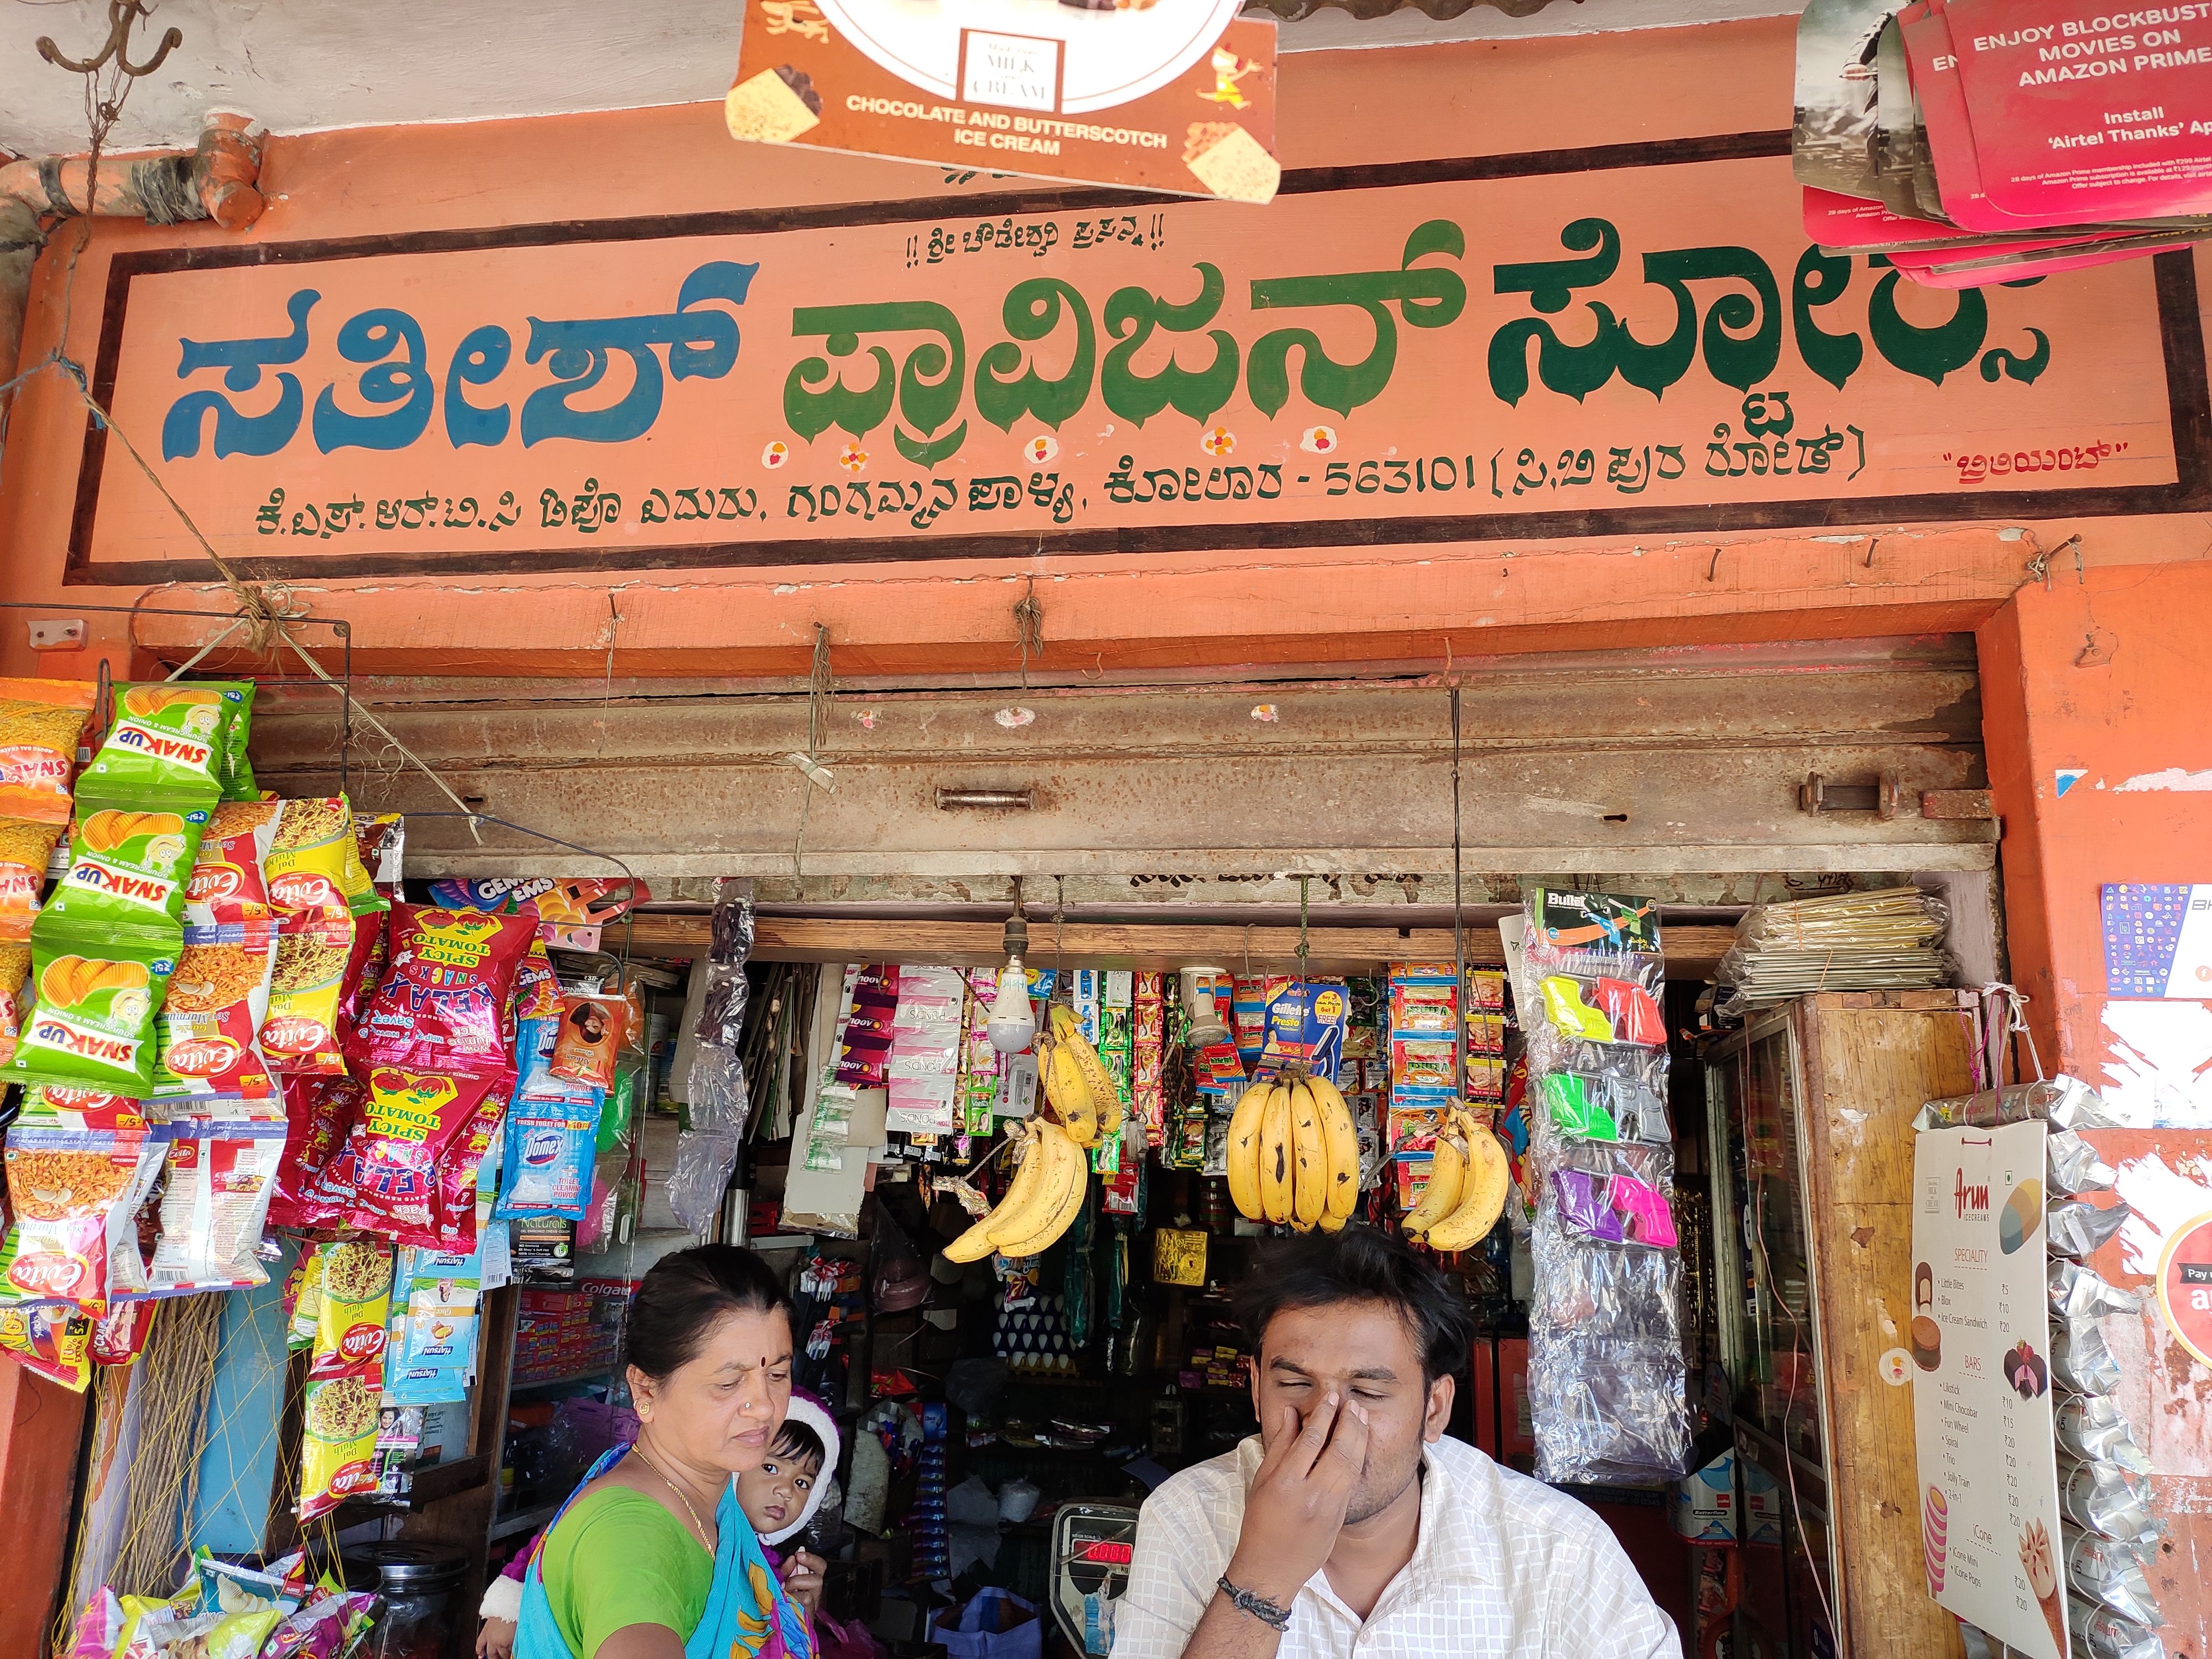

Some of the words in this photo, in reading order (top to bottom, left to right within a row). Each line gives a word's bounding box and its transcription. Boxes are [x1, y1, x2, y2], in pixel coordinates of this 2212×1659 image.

[1973, 24, 2055, 52] ENJOY
[2038, 32, 2136, 62] MOVIES
[2143, 28, 2181, 48] ON
[2019, 55, 2129, 87] AMAZON
[2134, 46, 2212, 71] PRIME
[846, 95, 966, 124] CHOCOLATE
[969, 112, 1011, 129] AND
[1014, 117, 1167, 148] BUTTERSCOTCH
[2104, 107, 2164, 126] Install
[954, 128, 987, 147] ICE
[989, 133, 1061, 155] CREAM
[2042, 176, 2069, 185] Amazon
[2069, 175, 2089, 183] Prime
[2089, 170, 2129, 181] subscription
[2136, 167, 2165, 176] available
[2045, 170, 2072, 179] Amazon
[2092, 164, 2132, 175] membership
[2132, 160, 2161, 170] included
[2089, 180, 2113, 189] subject
[2148, 174, 2158, 182] For
[163, 261, 760, 463] ಸತೀಶ್
[783, 218, 1467, 472] ಪ್ರಾವಿಜನ್
[1325, 455, 1476, 495] 563101
[128, 716, 153, 727] ONION
[160, 723, 186, 736] CREAM
[118, 731, 144, 747] UP
[187, 732, 207, 744] SOUR
[145, 738, 207, 763] SNAK
[85, 851, 112, 863] ONION
[118, 859, 146, 872] CREAM
[278, 859, 296, 870] Dal
[76, 867, 102, 885] UP
[149, 868, 169, 879] SOUR
[101, 875, 167, 901] SNAK
[269, 878, 331, 906] Evita
[1547, 893, 1587, 907] Bullet
[413, 935, 489, 954] TOMATO
[419, 948, 477, 967] SPICY
[409, 964, 478, 987] SNACKS
[382, 971, 496, 1014] RELAX
[47, 1007, 75, 1020] ONION
[273, 1001, 291, 1012] Dal
[84, 1018, 111, 1031] CREAM
[1271, 1015, 1300, 1026] Presto
[38, 1026, 66, 1045] UP
[115, 1027, 136, 1039] SOUR
[262, 1025, 325, 1051] Evita
[451, 1024, 487, 1038] Pack
[65, 1034, 133, 1062] SNAK
[447, 1035, 494, 1047] Jumbo
[169, 1045, 234, 1073] Evita
[904, 1061, 941, 1072] POND'S
[364, 1103, 439, 1129] TOMATO
[900, 1113, 936, 1124] POND'S
[368, 1120, 425, 1142] SPICY
[168, 1146, 191, 1159] Evita
[526, 1138, 564, 1159] Domex
[1954, 1166, 1989, 1219] Arun
[393, 1204, 429, 1217] Pack
[1963, 1214, 1990, 1222] ICECREAMS
[1954, 1248, 1988, 1264] SPECIALITY
[13, 1263, 82, 1291] Evita
[2188, 1269, 2207, 1281] Pay
[1941, 1278, 1952, 1289] Little
[1953, 1280, 1964, 1290] Bites
[2001, 1284, 2009, 1296] ₹5
[344, 1303, 364, 1316] Muth
[1941, 1295, 1951, 1306] Blox
[1999, 1302, 2010, 1314] ₹10
[351, 1310, 363, 1322] Dal
[1949, 1313, 1964, 1326] Cream
[1964, 1316, 1988, 1330] Sandwich
[1999, 1321, 2010, 1333] ₹20
[343, 1329, 384, 1354] Evita
[423, 1347, 452, 1355] HATSUN
[1964, 1355, 1981, 1371] BARS
[409, 1370, 437, 1379] HATSUN
[1943, 1381, 1960, 1396] Likstick
[2002, 1396, 2013, 1410] ₹10
[1944, 1401, 1954, 1414] Mini
[1954, 1402, 1978, 1418] Chocobar
[2003, 1415, 2014, 1428] ₹15
[1944, 1417, 1953, 1430] Fun
[1953, 1418, 1969, 1434] Wheel
[2004, 1434, 2015, 1448] ₹20
[333, 1439, 357, 1455] Muth
[343, 1448, 357, 1460] Dal
[1945, 1434, 1959, 1449] Spiral
[2006, 1454, 2016, 1468] ₹20
[1946, 1452, 1955, 1465] Trio
[2007, 1473, 2017, 1488] ₹20
[1947, 1471, 1958, 1486] Jolly
[1958, 1474, 1970, 1489] Train
[2008, 1493, 2019, 1508] ₹20
[1948, 1489, 1962, 1504] 2-in-1
[2009, 1512, 2021, 1527] ₹20
[1973, 1523, 1992, 1544] iCone
[1952, 1546, 1967, 1563] iCone
[1967, 1553, 1979, 1568] Mini
[2014, 1574, 2026, 1590] ₹20
[1954, 1564, 1968, 1580] iCone
[1968, 1571, 1981, 1588] Pops
[2016, 1595, 2027, 1611] ₹20
